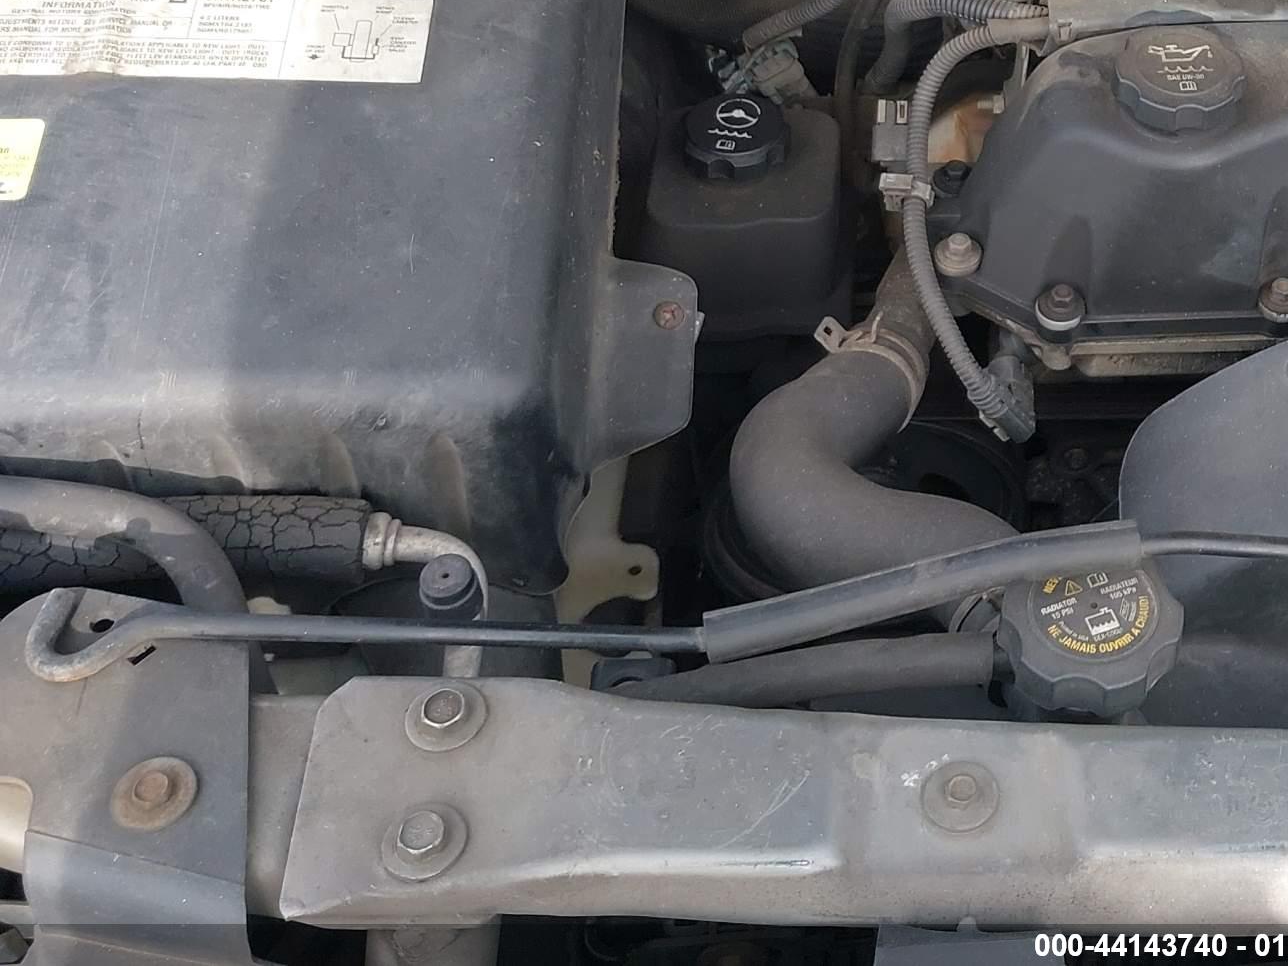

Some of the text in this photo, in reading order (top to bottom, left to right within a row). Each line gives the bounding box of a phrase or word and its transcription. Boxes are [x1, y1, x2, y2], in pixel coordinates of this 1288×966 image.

[42, 0, 116, 9] INFORMATION
[1100, 576, 1139, 595] RADIATEUR
[1040, 597, 1078, 616] RADIATOR
[1058, 636, 1097, 653] JAMAIS
[1099, 633, 1135, 653] OUVRIR
